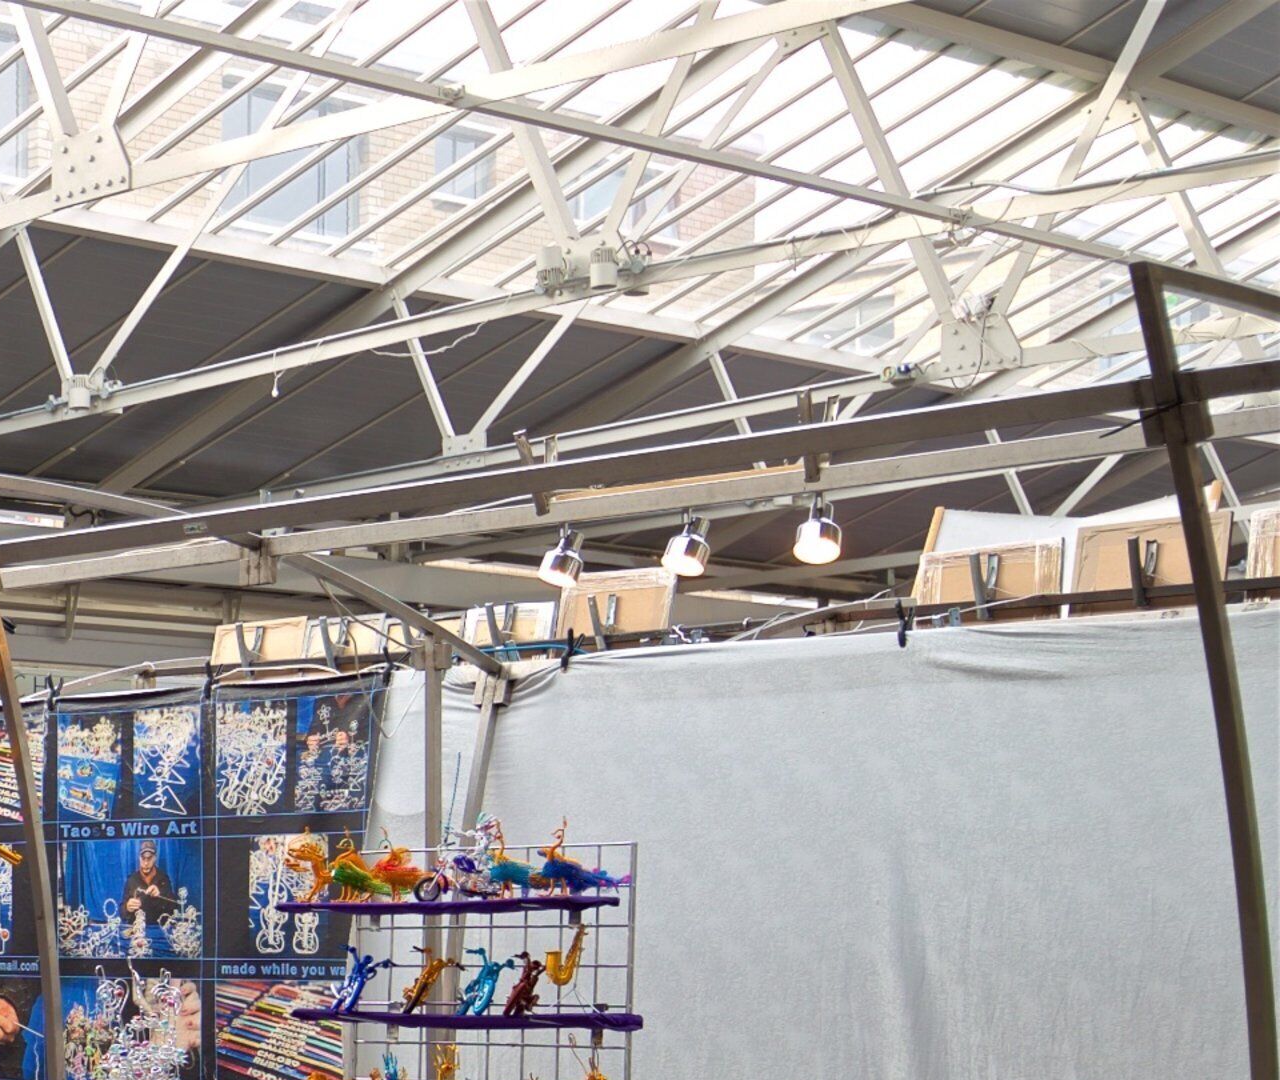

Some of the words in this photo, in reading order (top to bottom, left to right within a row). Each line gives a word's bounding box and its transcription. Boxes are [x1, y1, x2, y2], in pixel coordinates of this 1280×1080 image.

[121, 822, 160, 837] Wire
[165, 820, 197, 835] Art
[220, 963, 257, 975] made
[261, 963, 298, 975] while
[301, 965, 326, 978] you
